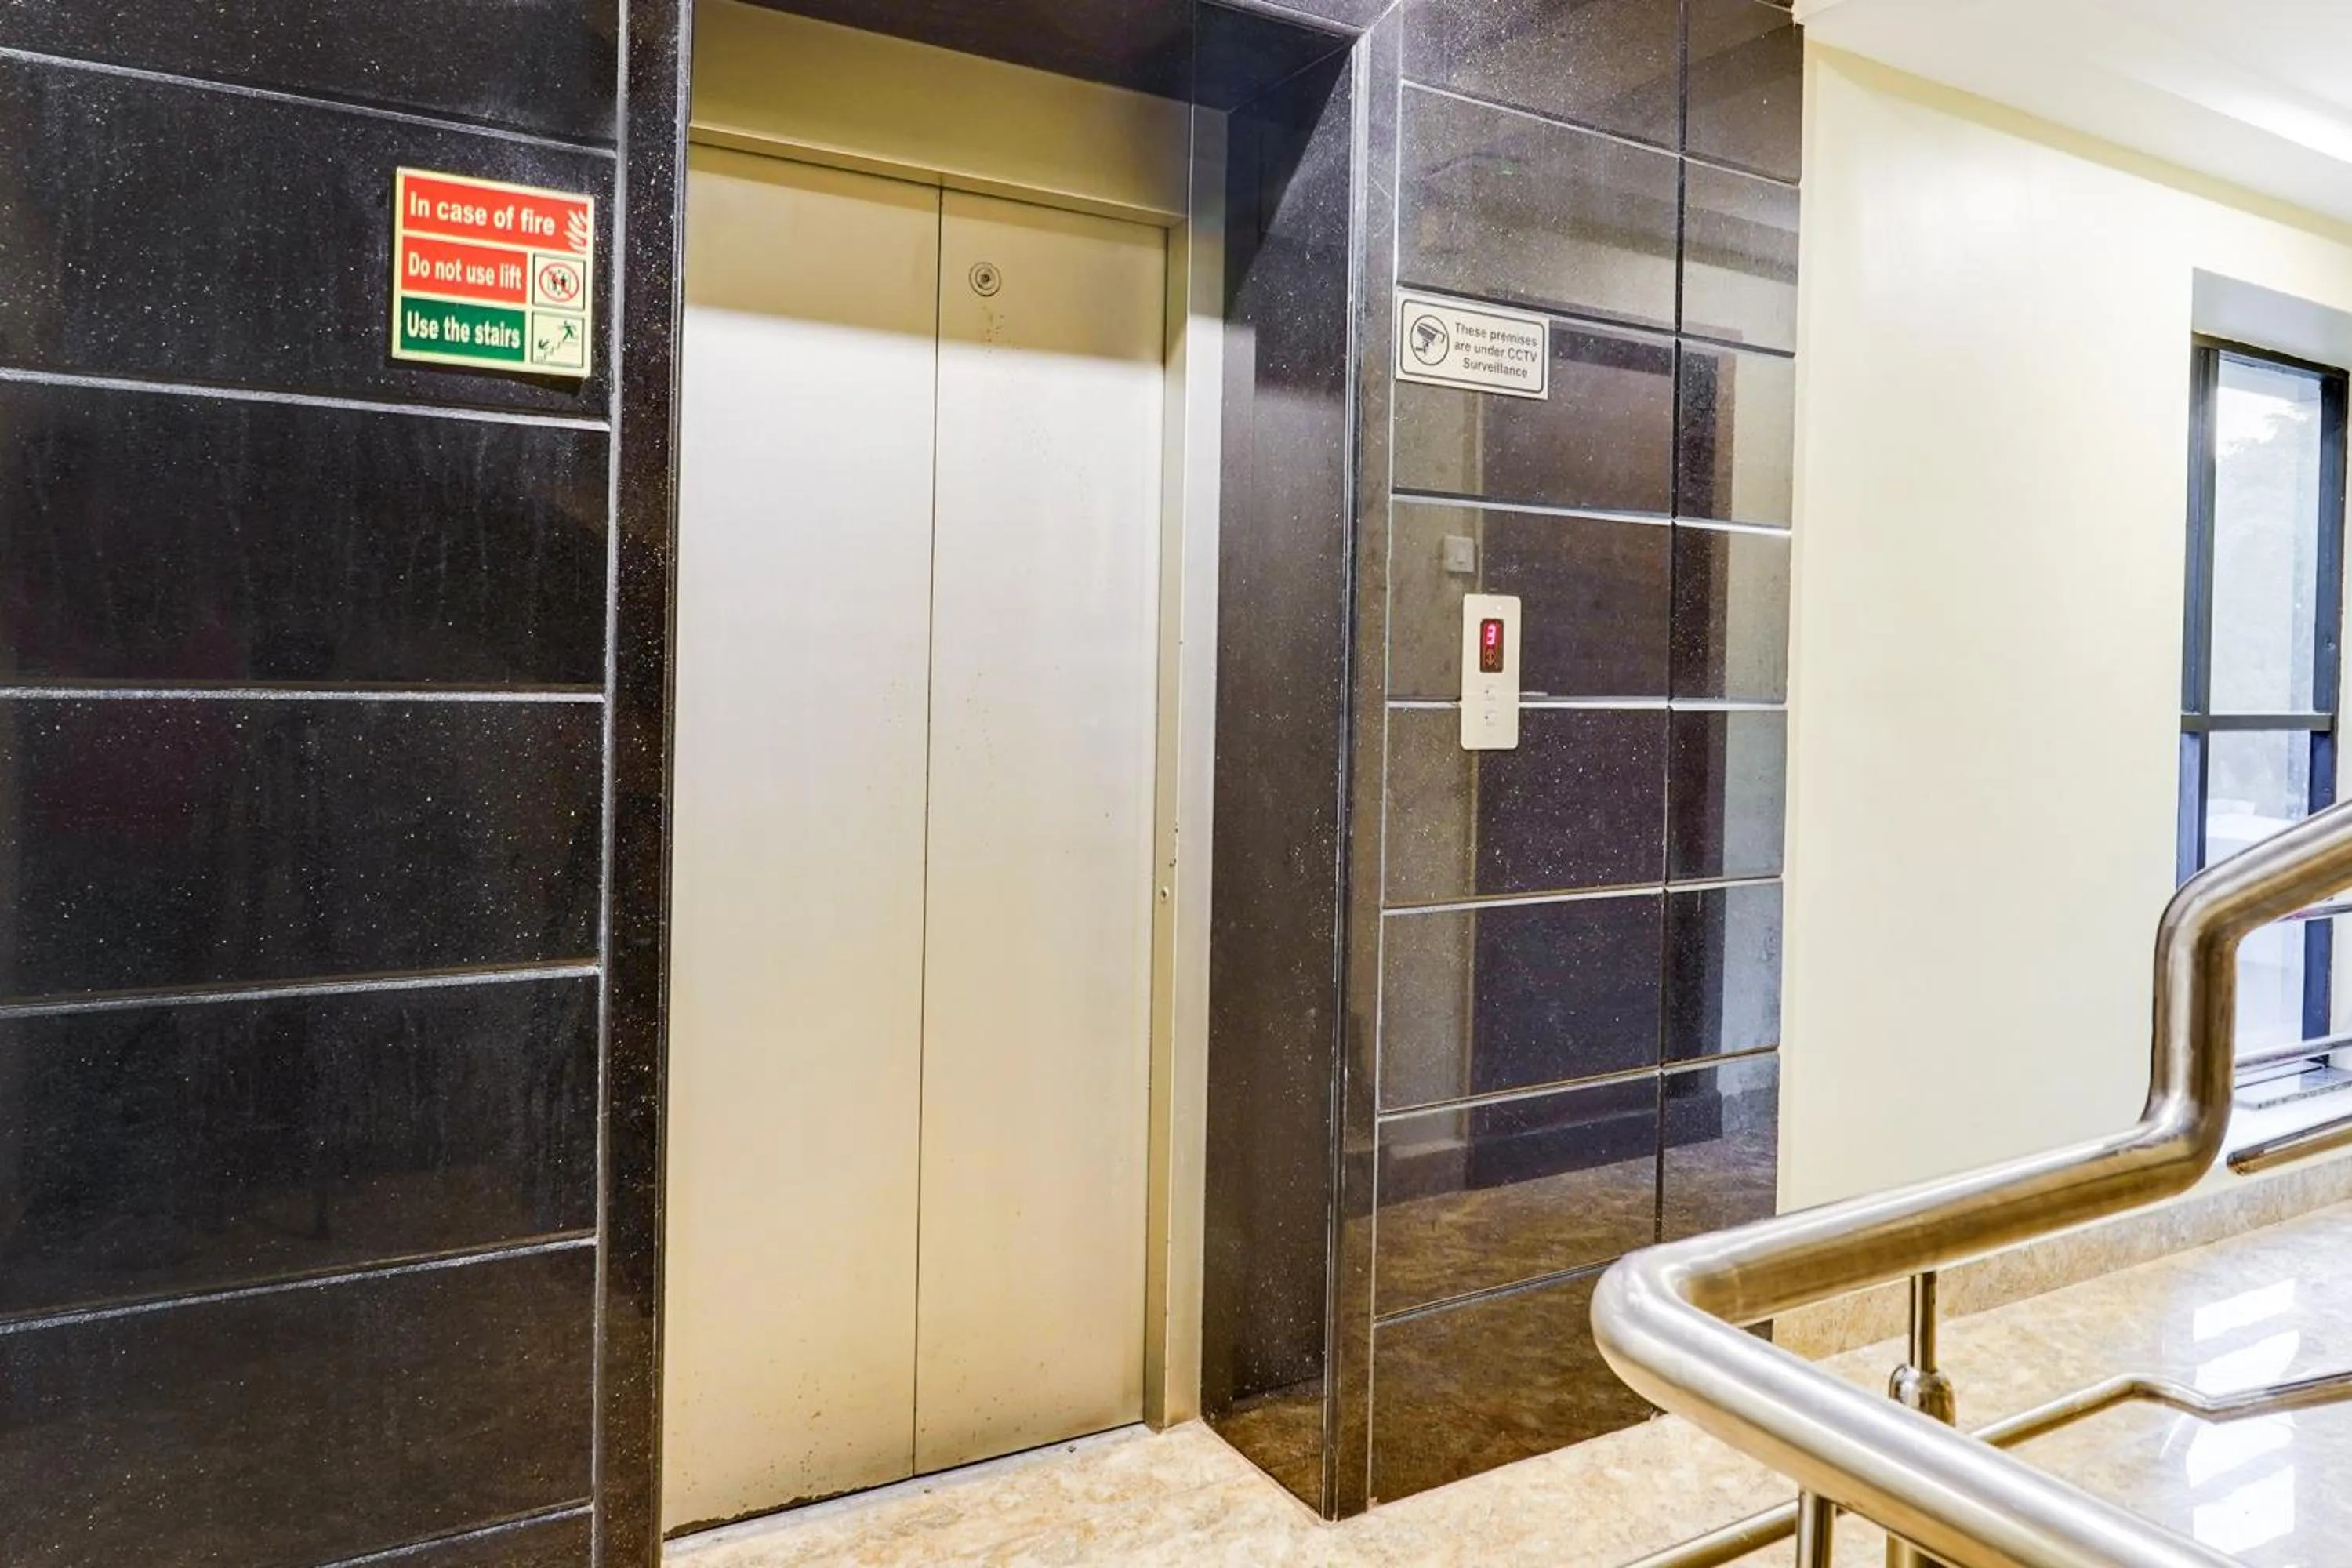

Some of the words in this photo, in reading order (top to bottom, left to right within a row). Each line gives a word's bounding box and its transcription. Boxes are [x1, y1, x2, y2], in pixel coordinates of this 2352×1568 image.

[409, 191, 430, 218] In
[437, 201, 488, 226] case
[493, 205, 514, 230] of
[520, 209, 556, 235] fire
[408, 251, 430, 277] Do
[435, 258, 462, 282] not
[466, 264, 495, 286] use
[499, 263, 522, 289] lift
[406, 310, 439, 339] Use
[444, 315, 470, 343] the
[474, 321, 520, 349] stairs
[1455, 322, 1486, 339] These
[1490, 330, 1537, 347] premises
[1454, 341, 1471, 353] are
[1474, 343, 1504, 358] under
[1508, 347, 1537, 363] CCTV
[1462, 357, 1528, 379] Surveillance
